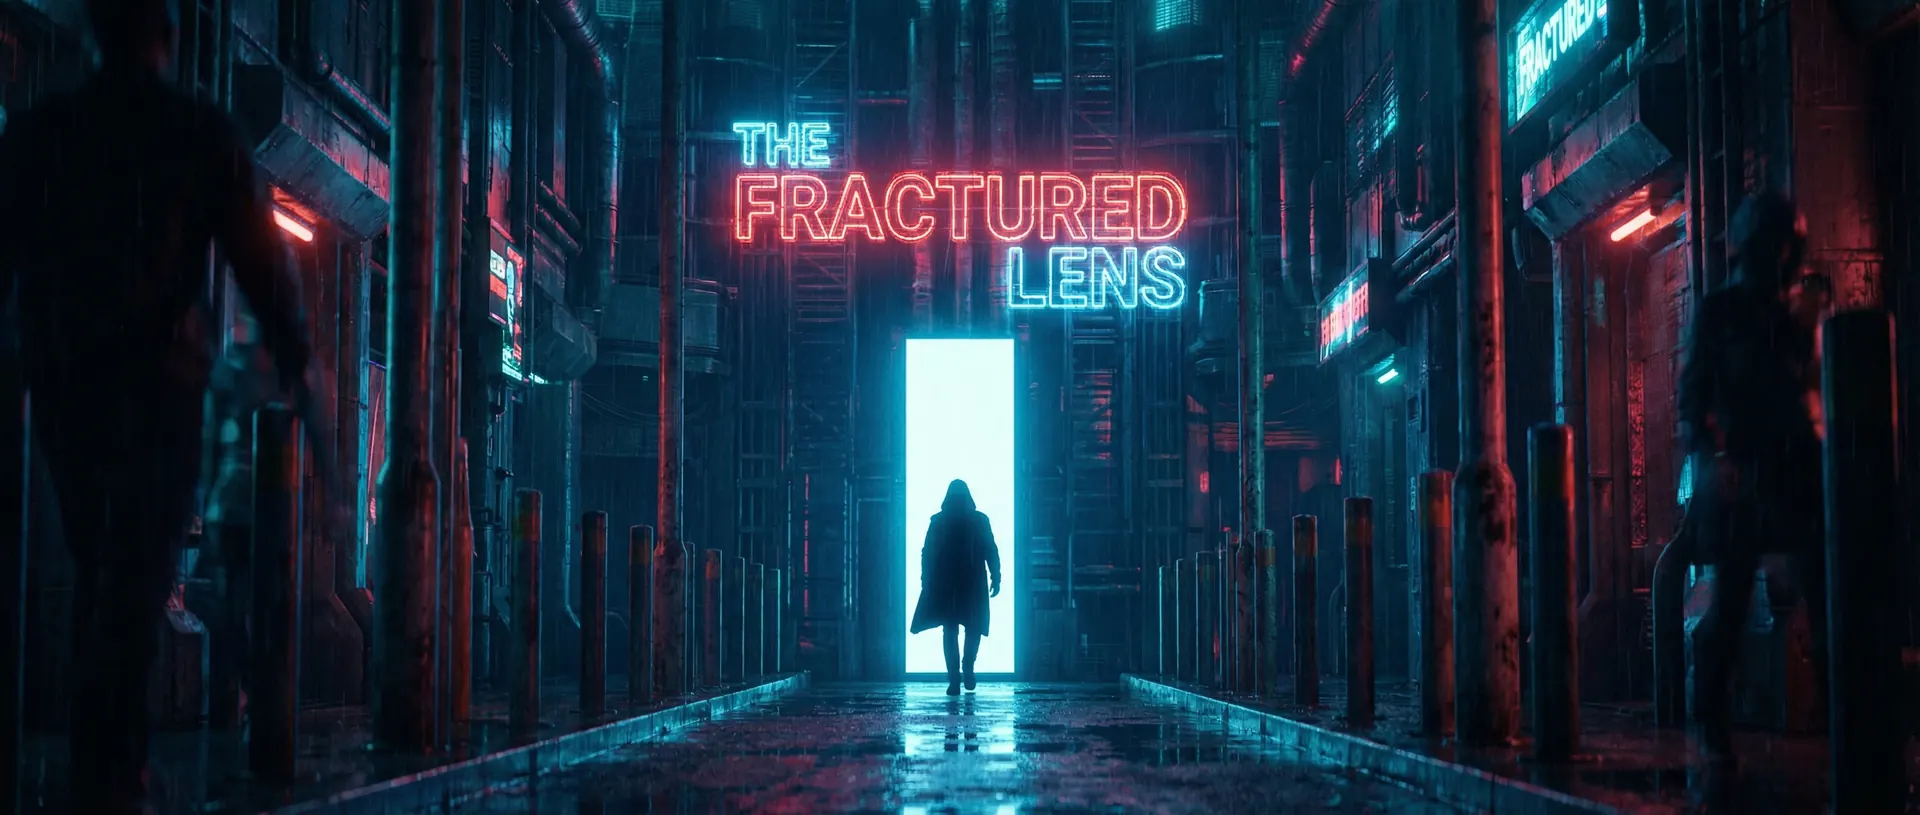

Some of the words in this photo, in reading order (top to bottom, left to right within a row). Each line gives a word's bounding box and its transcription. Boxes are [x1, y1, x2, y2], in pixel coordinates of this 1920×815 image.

[733, 122, 831, 167] THE
[735, 173, 1188, 243] FRACTURED
[1007, 246, 1187, 310] LENS
